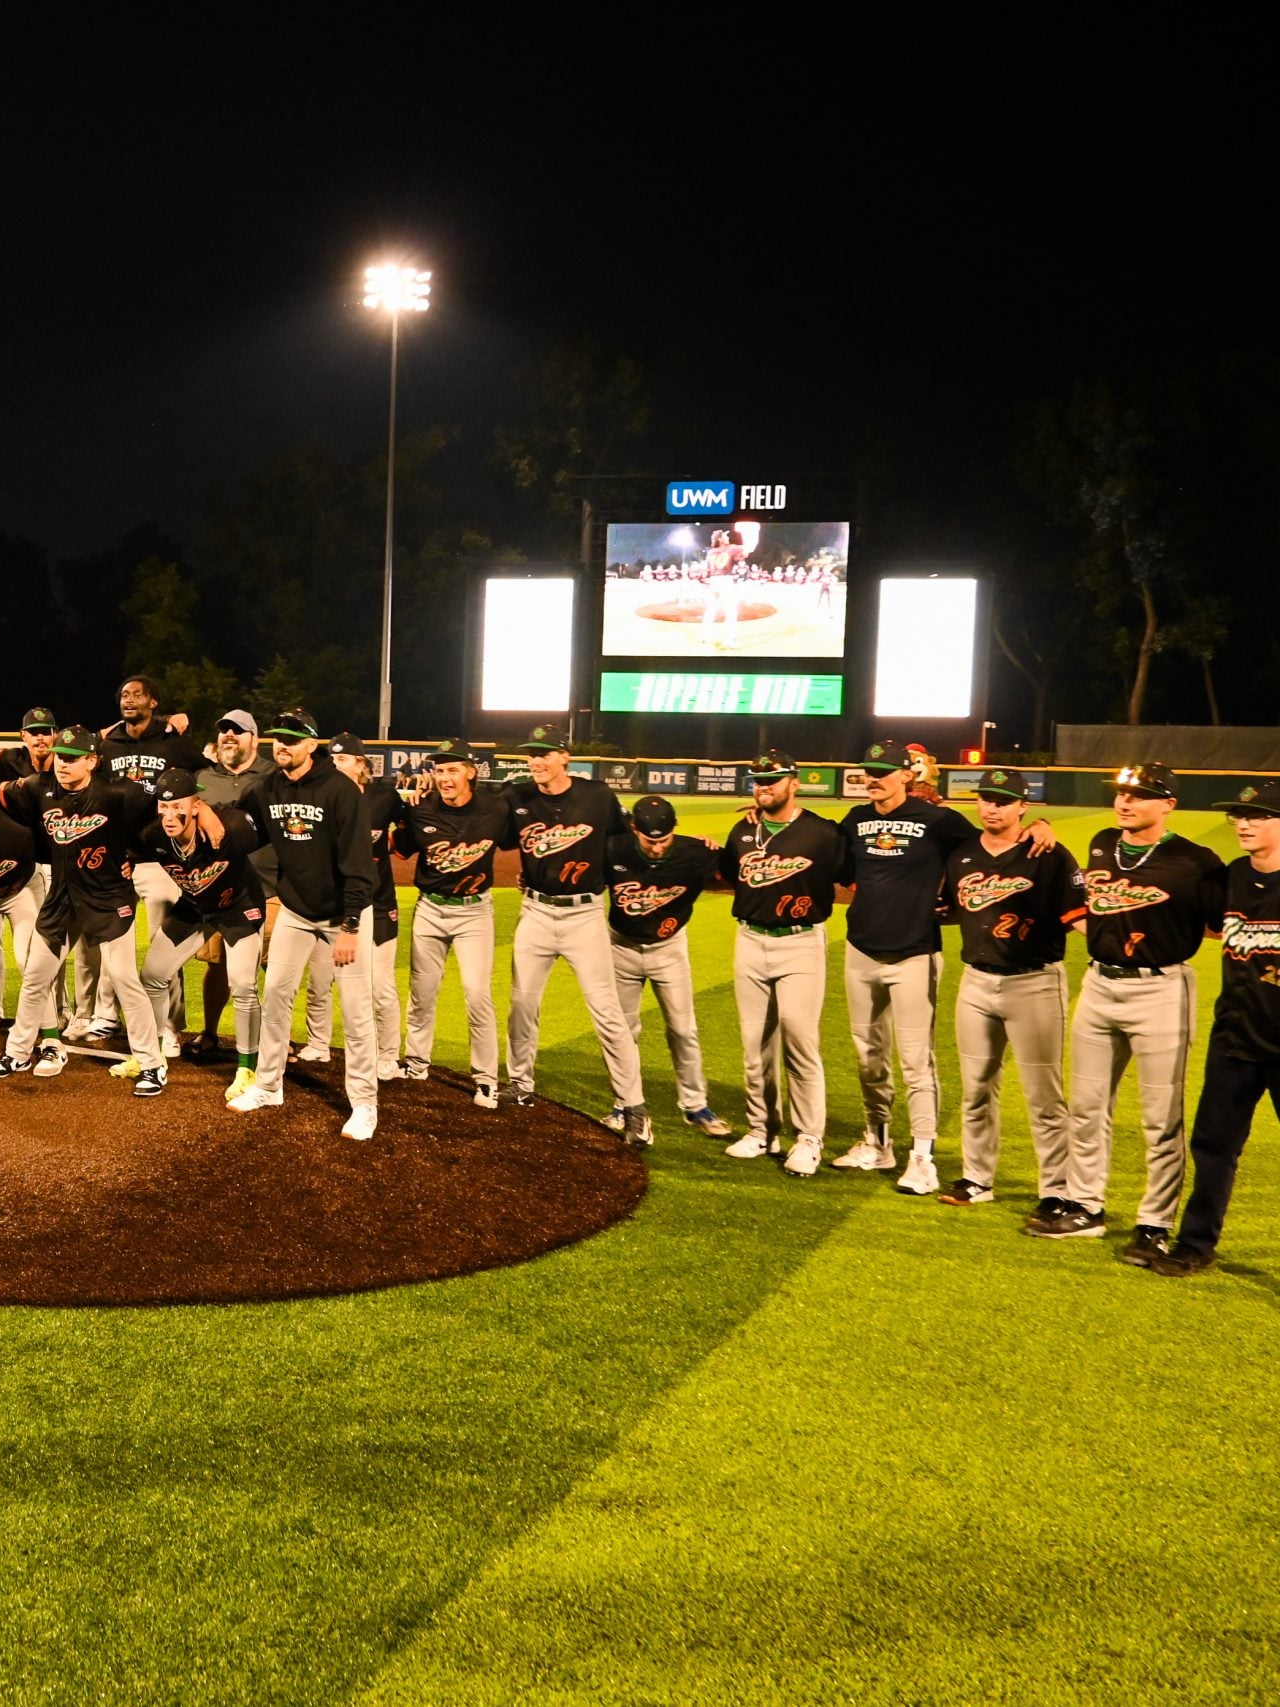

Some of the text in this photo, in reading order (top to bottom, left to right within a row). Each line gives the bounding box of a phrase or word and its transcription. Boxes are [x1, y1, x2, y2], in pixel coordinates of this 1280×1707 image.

[671, 484, 787, 510] UWM FIELD
[111, 754, 167, 772] HOPPERS
[648, 771, 687, 786] DTE
[43, 808, 108, 843] Eastside
[857, 820, 927, 838] HOPPERS
[76, 846, 107, 870] 15
[866, 846, 905, 857] BASEBALL
[739, 850, 813, 888] Eastside
[958, 872, 1034, 912] Eastside
[1086, 869, 1170, 915] Eastside
[775, 894, 813, 919] 18
[657, 917, 678, 939] 8
[1241, 923, 1280, 932] DIAMON
